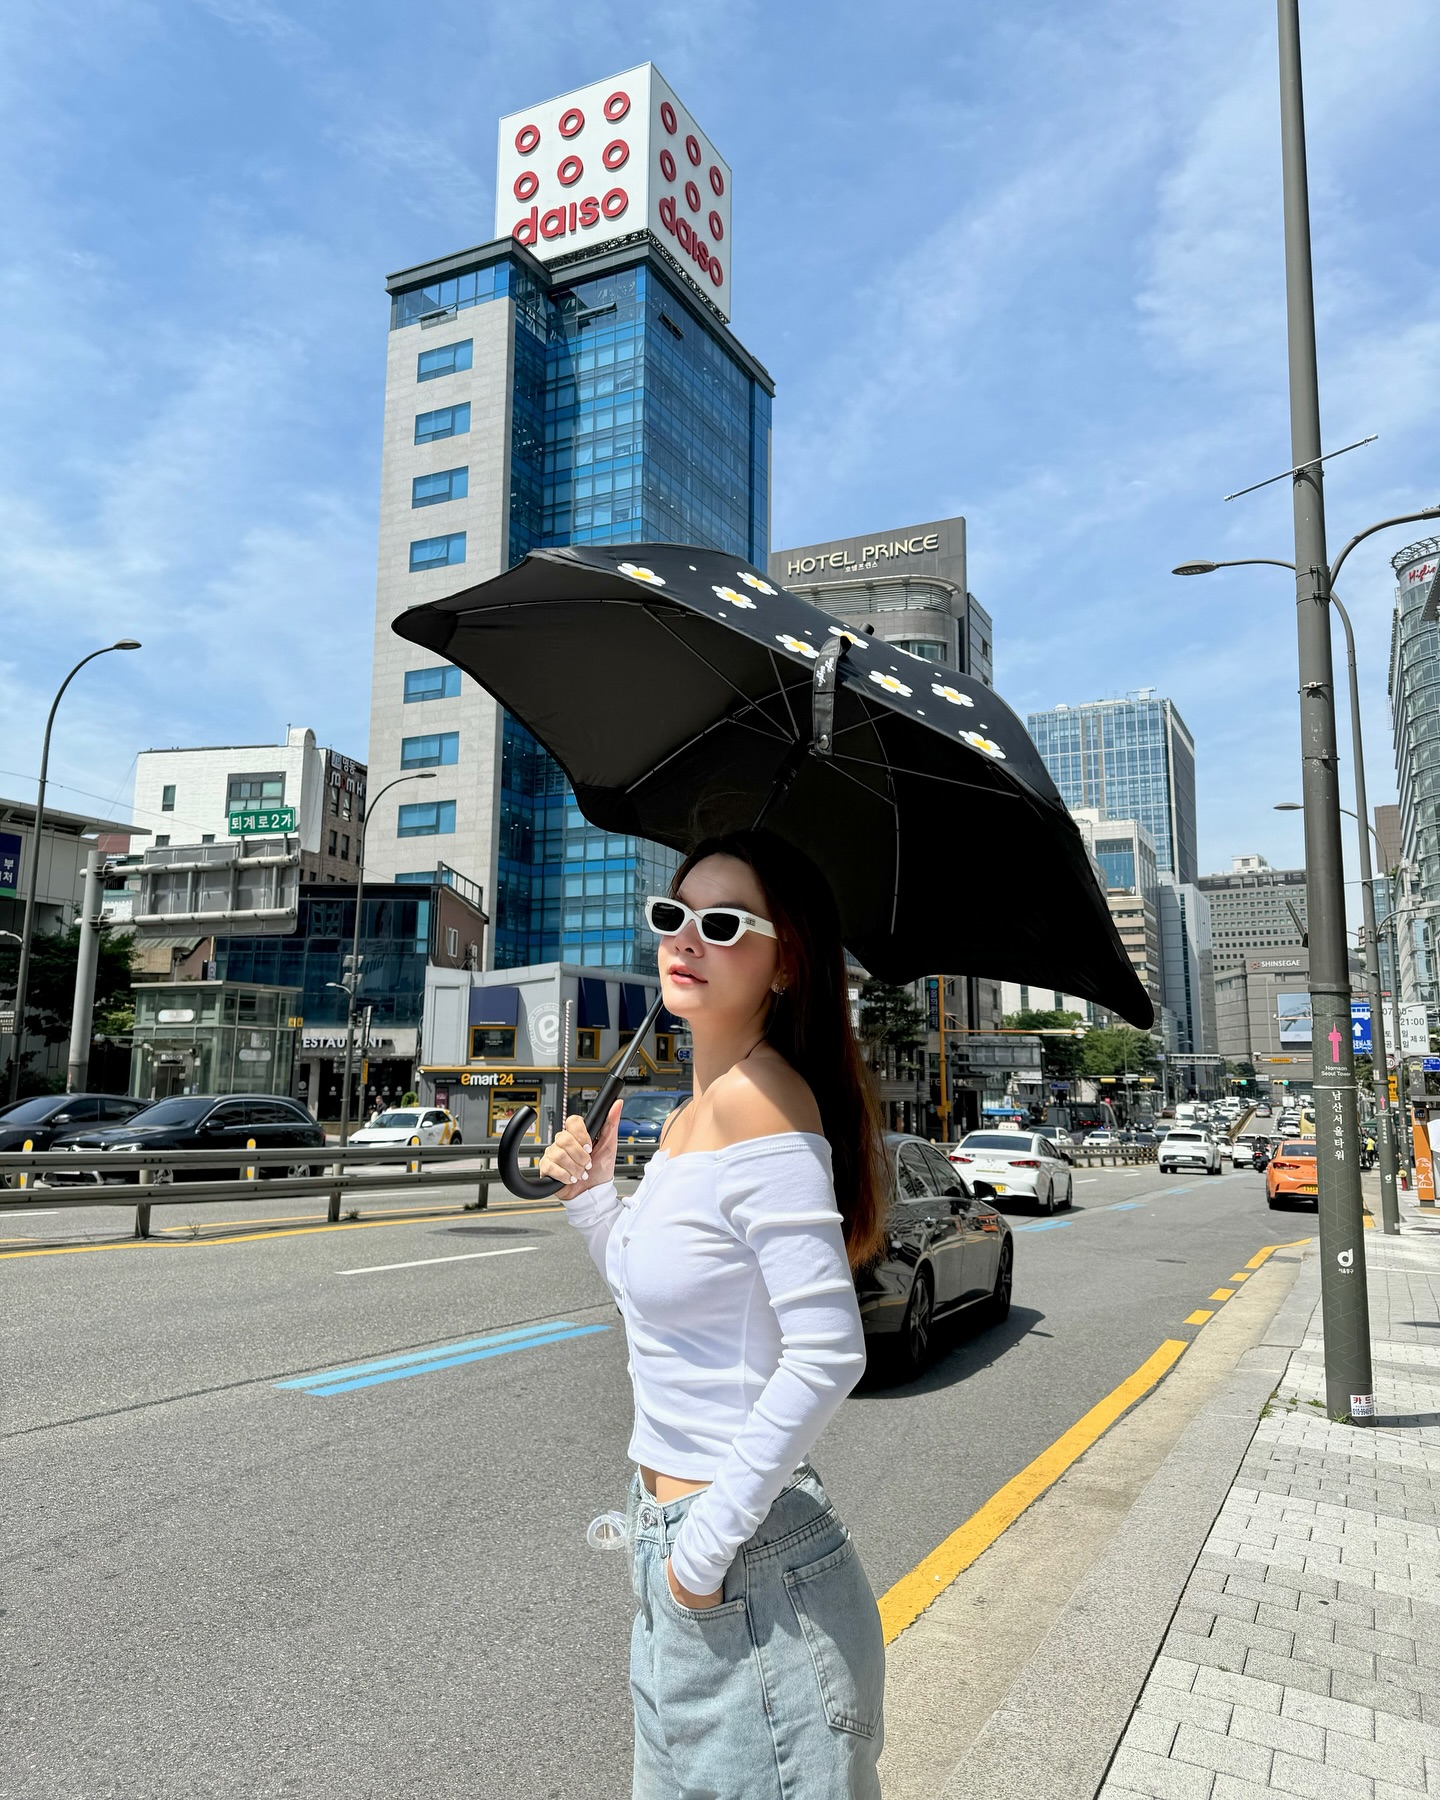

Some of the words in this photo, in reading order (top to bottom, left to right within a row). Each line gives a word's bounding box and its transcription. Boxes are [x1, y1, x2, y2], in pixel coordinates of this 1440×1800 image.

[512, 187, 629, 246] daiso
[658, 195, 723, 287] daiso
[788, 551, 855, 576] HOTEL
[862, 533, 939, 562] PRINCE
[231, 812, 292, 830] 퇴계로2가
[1261, 960, 1301, 968] SHINSEGAE
[1400, 1017, 1425, 1026] 21:00
[461, 1073, 515, 1086] emart24
